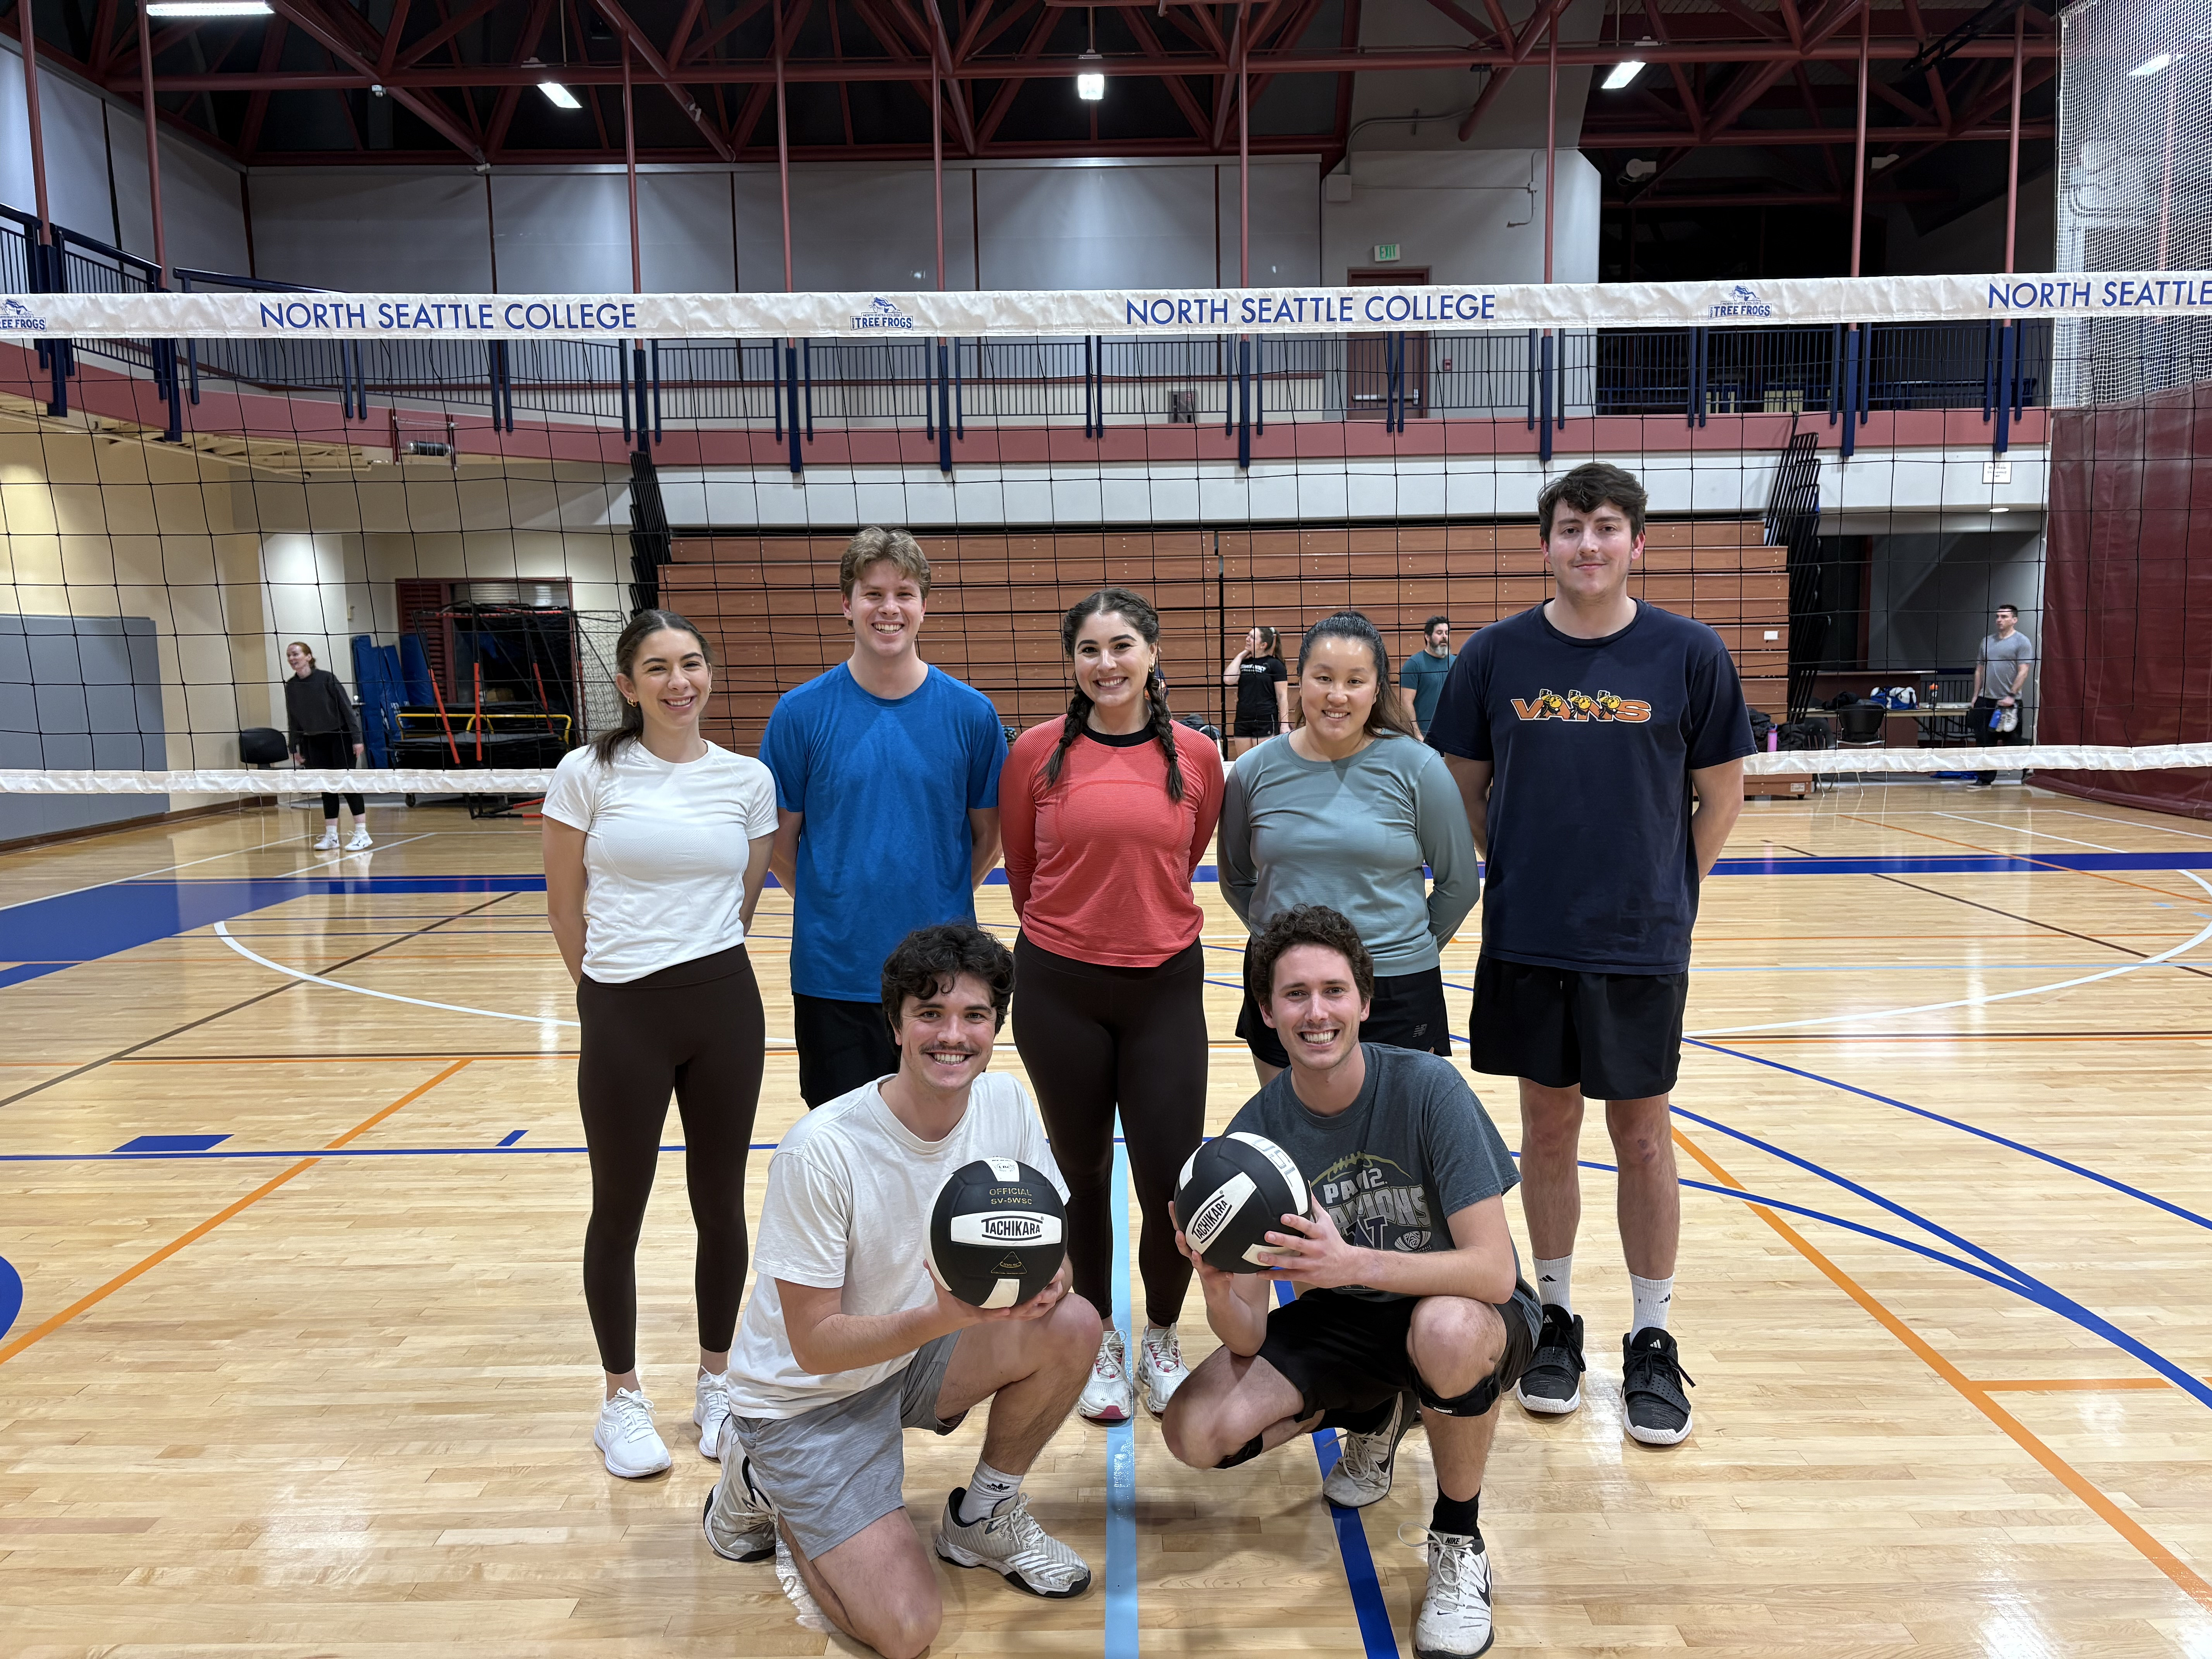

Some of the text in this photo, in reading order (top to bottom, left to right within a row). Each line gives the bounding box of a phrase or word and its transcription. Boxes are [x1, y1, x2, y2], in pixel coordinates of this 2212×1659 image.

[1989, 280, 2212, 309] NORTH SEATTLE
[260, 302, 636, 329] NORTH SEATTLE COLLEGE
[1127, 294, 1495, 325] NORTH SEATTLE COLLEGE
[1714, 306, 1739, 317] TREE
[1741, 305, 1770, 316] FROGS
[15, 319, 45, 330] FROGS
[855, 317, 880, 328] TREE
[882, 317, 912, 328] FROGS
[1511, 698, 1651, 723] VANS
[989, 1188, 1032, 1197] OFFICIAL
[981, 1217, 1041, 1236] TACHIKARA
[1192, 1200, 1228, 1240] TACHIKARA
